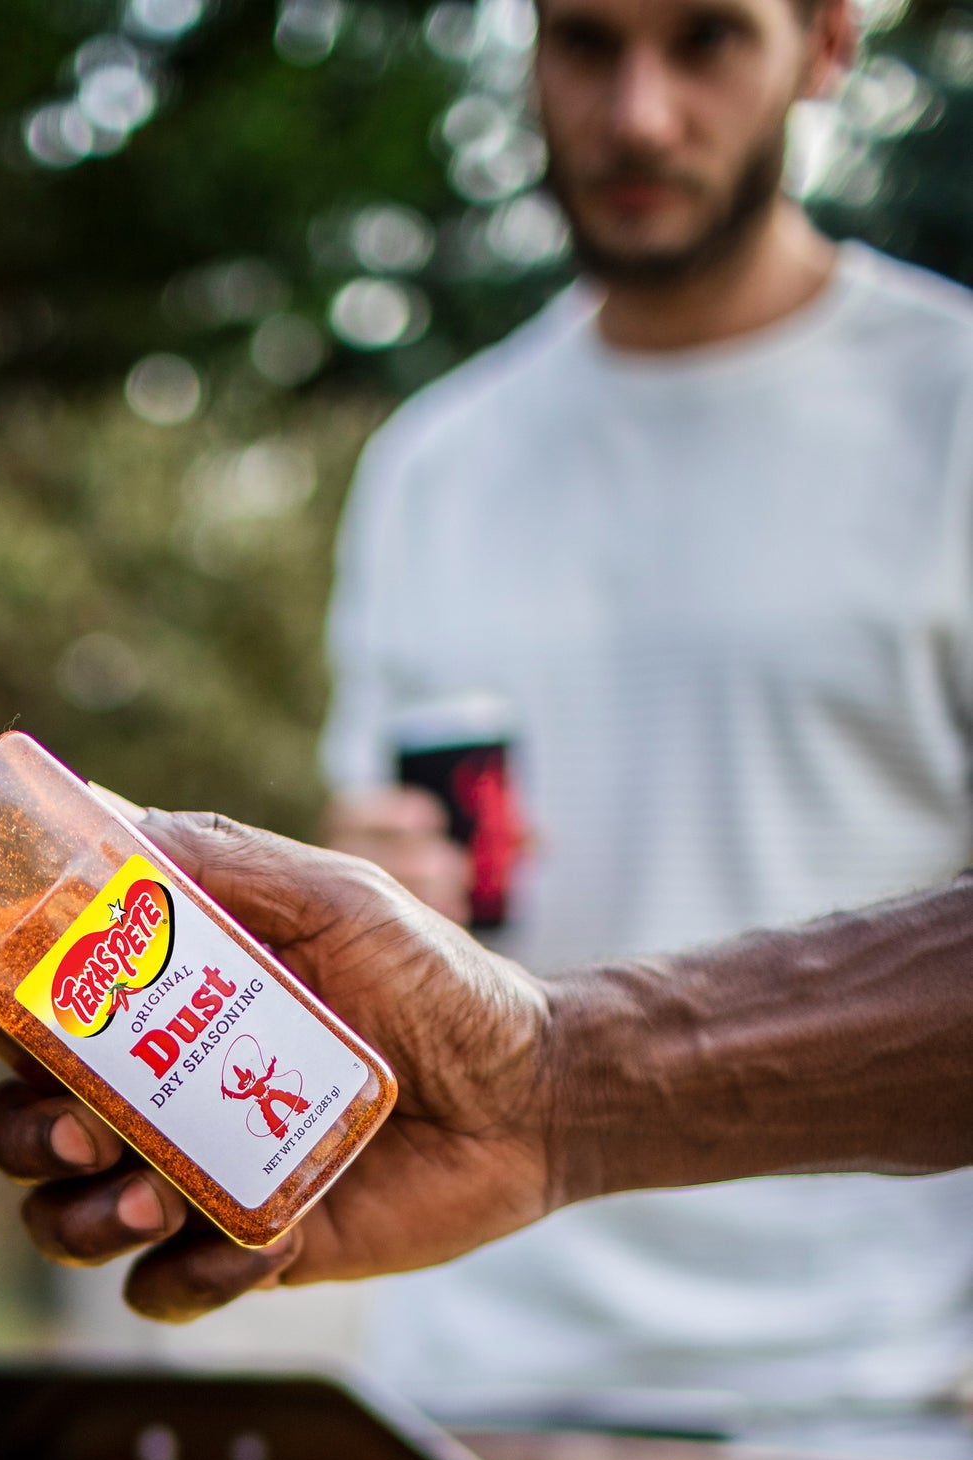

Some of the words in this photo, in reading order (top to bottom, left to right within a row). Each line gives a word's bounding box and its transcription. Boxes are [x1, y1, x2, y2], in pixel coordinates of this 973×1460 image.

[55, 944, 120, 1024] TEXAS
[108, 893, 163, 977] PETE
[131, 965, 193, 1033] ORIGINAL
[129, 965, 237, 1080] Dust
[150, 1071, 183, 1108] DRY
[183, 978, 264, 1072] SEASONING
[262, 1153, 282, 1175] NET
[280, 1138, 296, 1155] WT
[294, 1127, 305, 1140] 10
[303, 1114, 317, 1128] OZ
[314, 1094, 332, 1116] (283
[331, 1086, 341, 1099] g)
